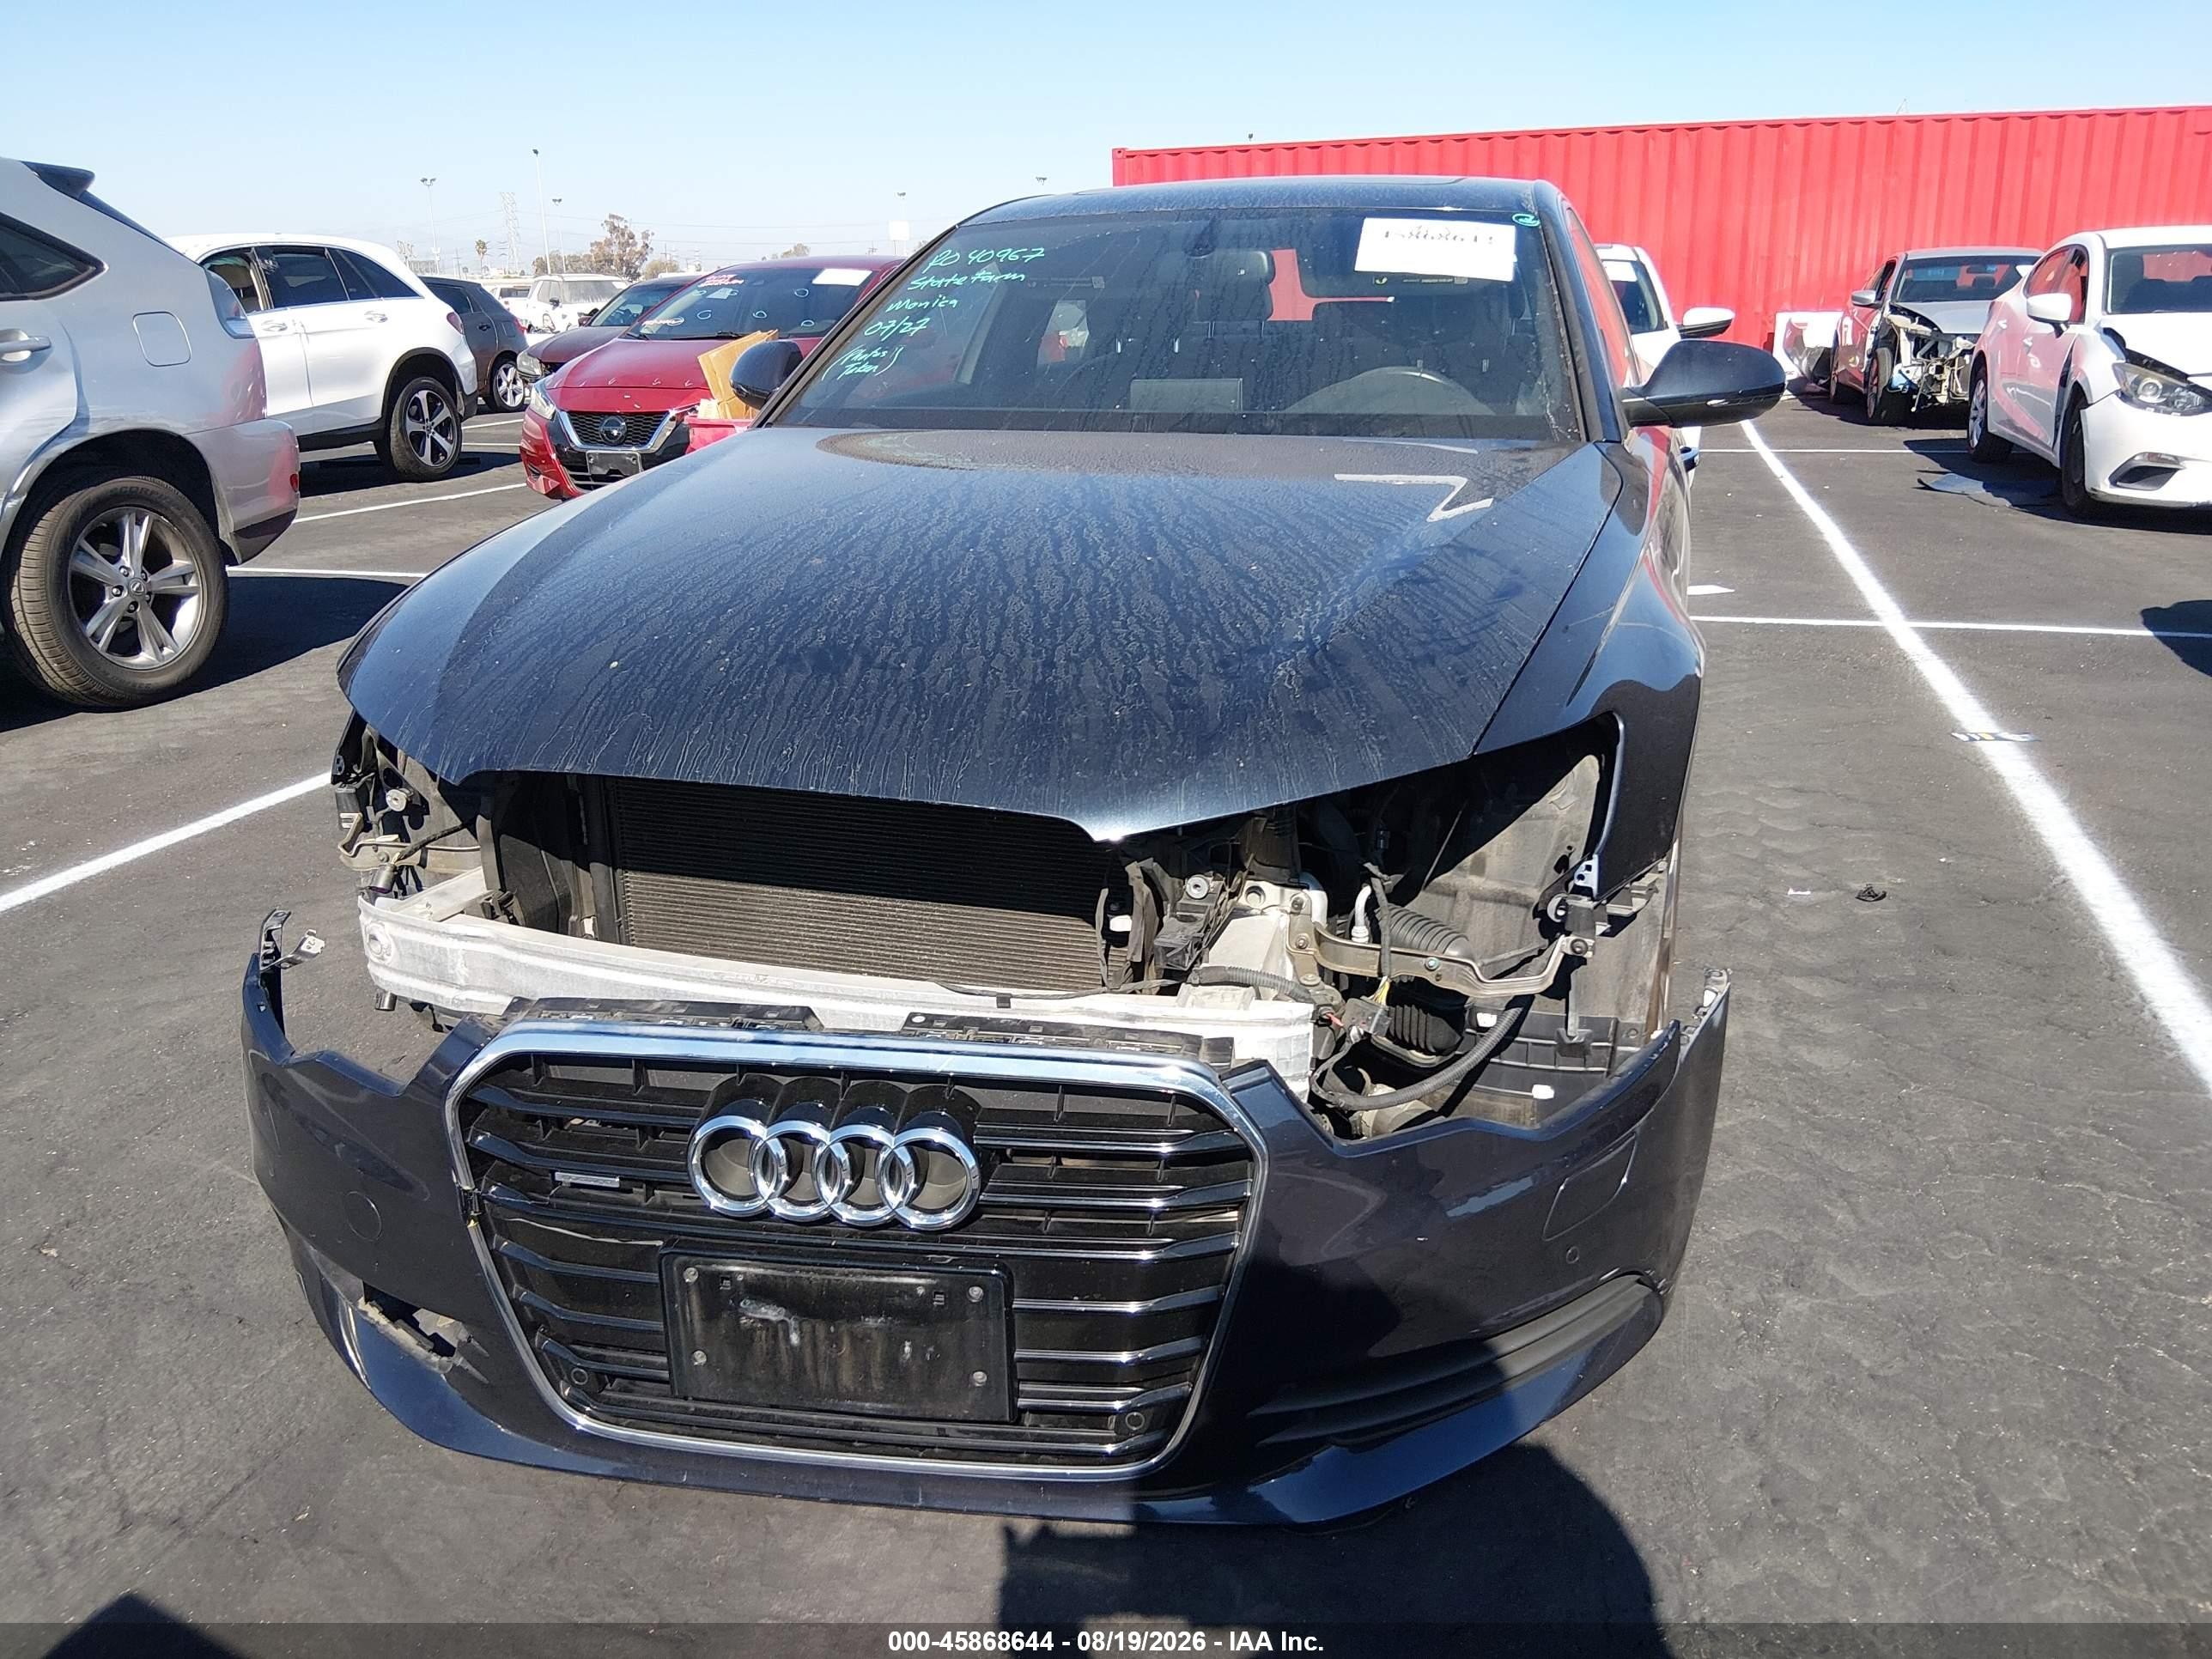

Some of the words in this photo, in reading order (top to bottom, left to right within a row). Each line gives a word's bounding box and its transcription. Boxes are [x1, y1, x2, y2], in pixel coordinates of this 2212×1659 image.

[922, 249, 960, 274] RO
[968, 247, 1045, 264] 40967
[908, 274, 968, 290] State
[971, 270, 1025, 283] Farm
[885, 295, 957, 313] Monica
[865, 316, 931, 342] 07/27
